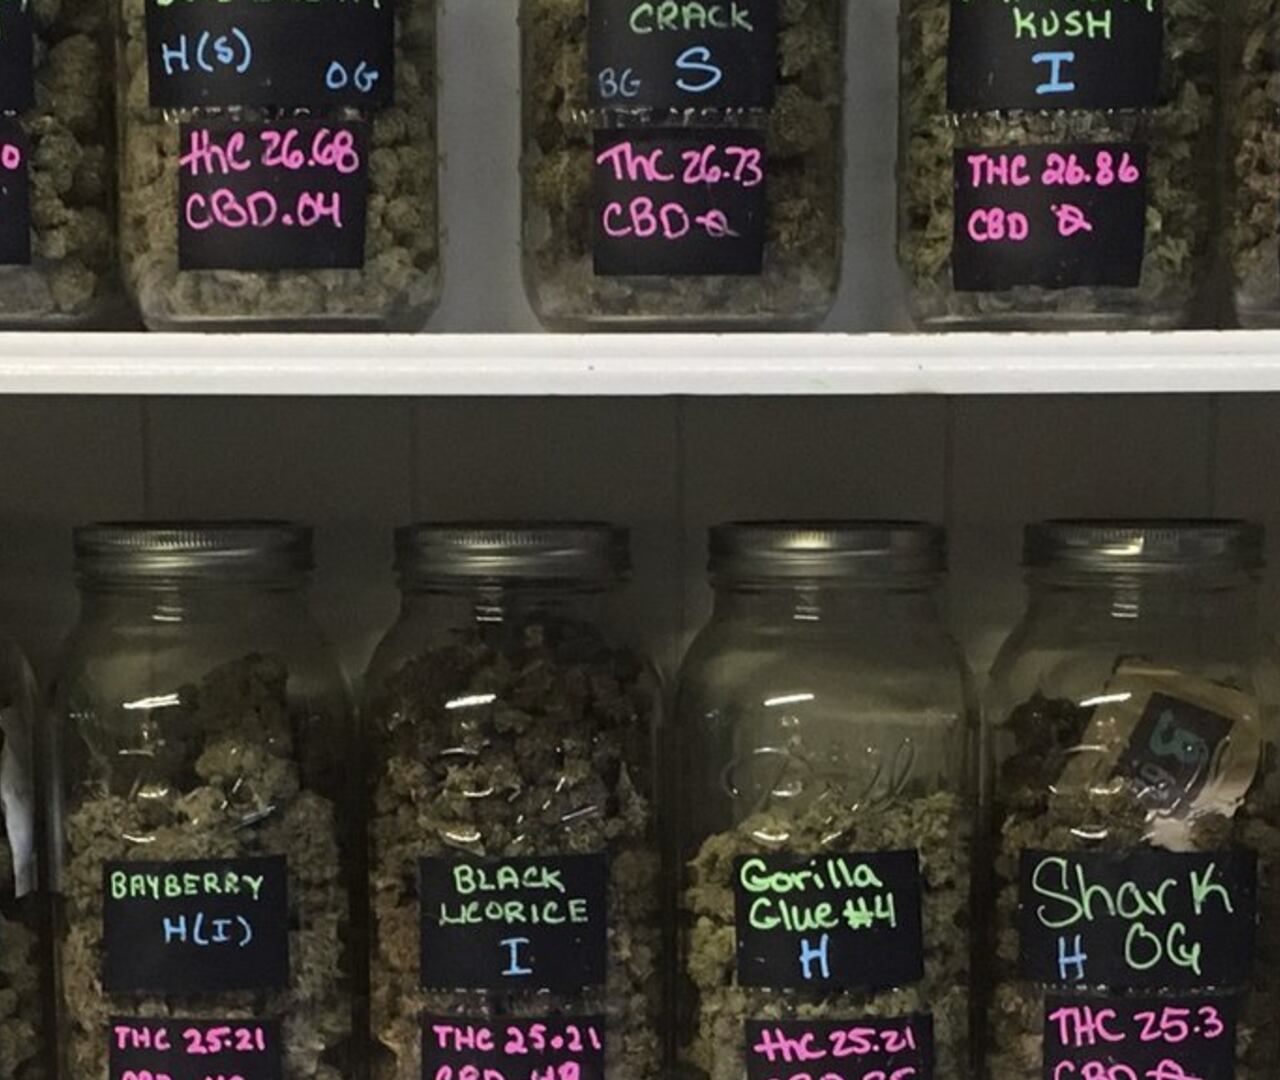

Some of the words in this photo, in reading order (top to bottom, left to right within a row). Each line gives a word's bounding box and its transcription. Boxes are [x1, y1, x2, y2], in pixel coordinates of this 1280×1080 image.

[629, 2, 753, 34] CRACK
[1013, 6, 1112, 39] KUSH
[161, 27, 252, 75] H(S)
[325, 61, 379, 92] OG
[598, 67, 641, 98] BG
[675, 46, 722, 92] S
[1032, 51, 1075, 95] I
[260, 128, 360, 173] 26.68
[681, 144, 763, 186] 26.73
[967, 154, 1030, 188] THC
[1041, 151, 1140, 186] 26.86
[185, 188, 278, 230] CBD
[281, 191, 343, 228] .04
[602, 196, 689, 239] CBD
[967, 206, 1029, 241] CBD
[110, 871, 264, 901] BAYBERRY
[453, 863, 566, 894] BLACK
[740, 858, 883, 892] Gorilla
[439, 899, 589, 927] LICORICE
[749, 897, 839, 930] Glue
[843, 892, 897, 929] #4
[499, 937, 532, 976] I
[799, 933, 830, 979] H
[1057, 934, 1087, 980] H
[1124, 921, 1201, 976] OG
[114, 1026, 171, 1050] THC
[182, 1026, 265, 1055] 25.21
[432, 1024, 495, 1051] THC
[504, 1023, 602, 1055] 25.21
[829, 1026, 916, 1056] 25.21
[1048, 1007, 1126, 1046] THC
[1134, 1005, 1223, 1042] 25.3
